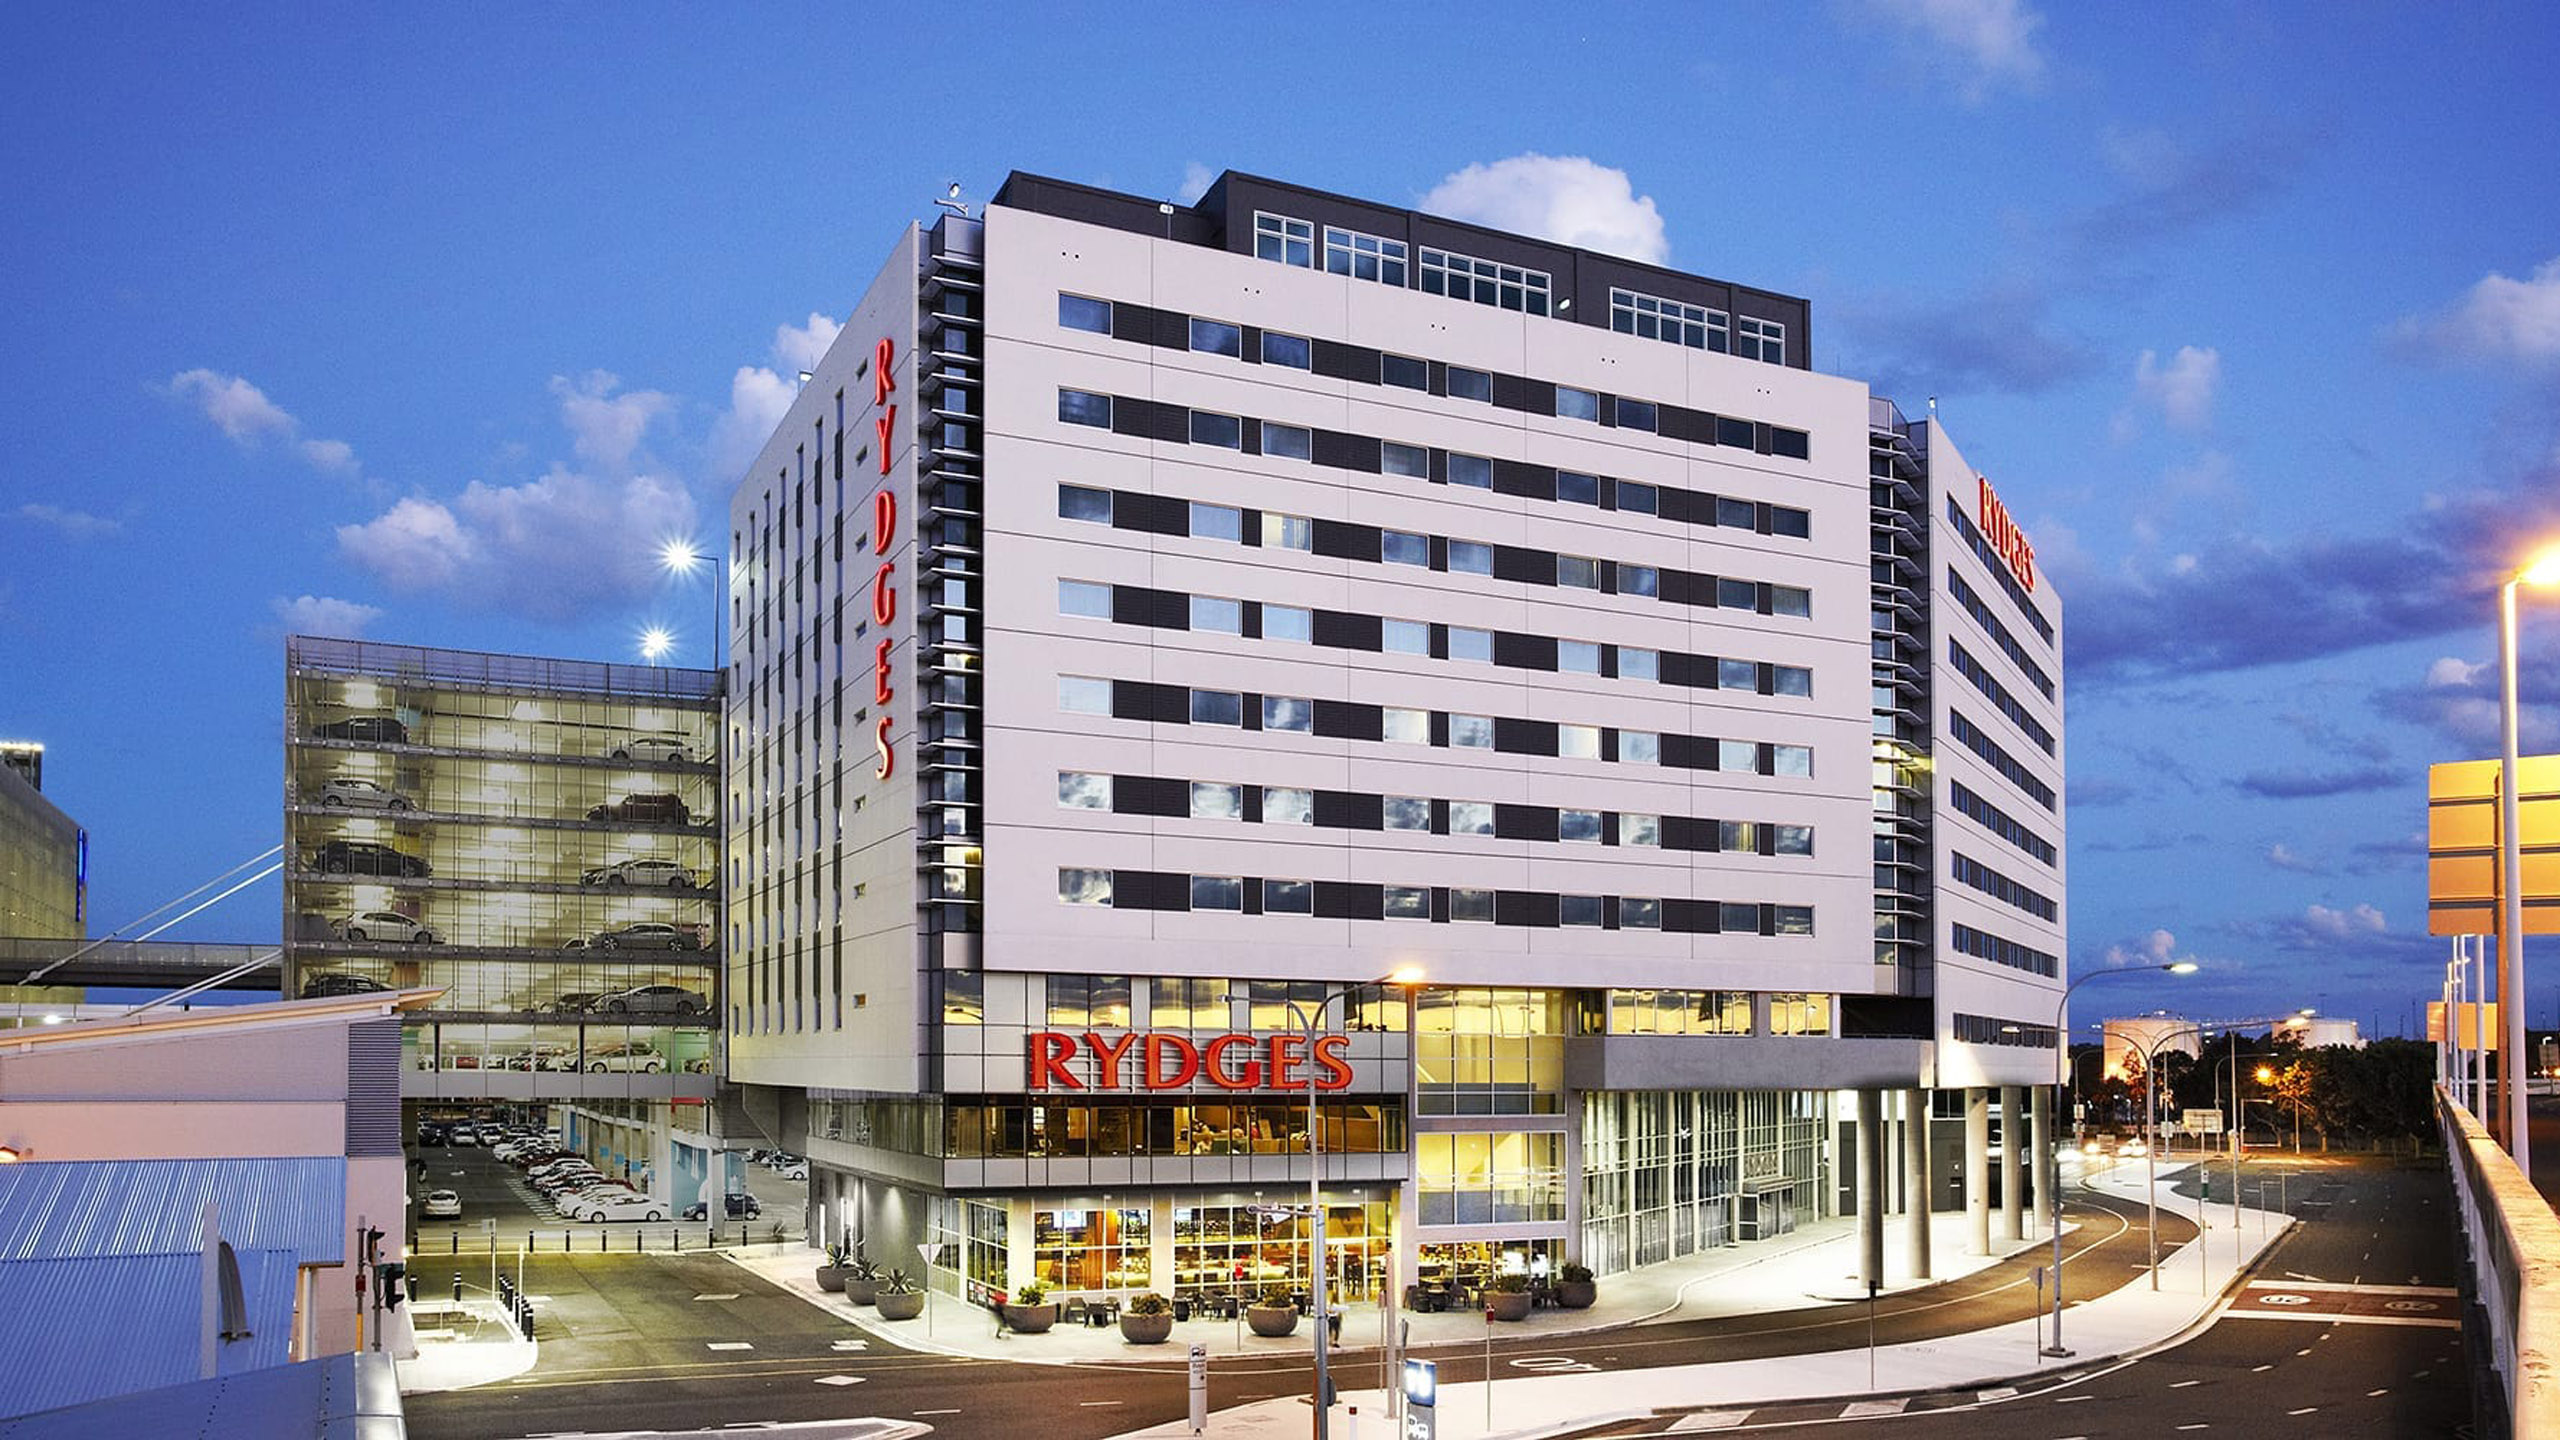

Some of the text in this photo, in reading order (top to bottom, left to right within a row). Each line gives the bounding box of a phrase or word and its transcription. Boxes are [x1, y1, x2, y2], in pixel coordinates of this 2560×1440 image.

[873, 338, 896, 780] RYDGES
[1979, 477, 2035, 593] RYDGES
[1030, 1032, 1353, 1090] RYDGES
